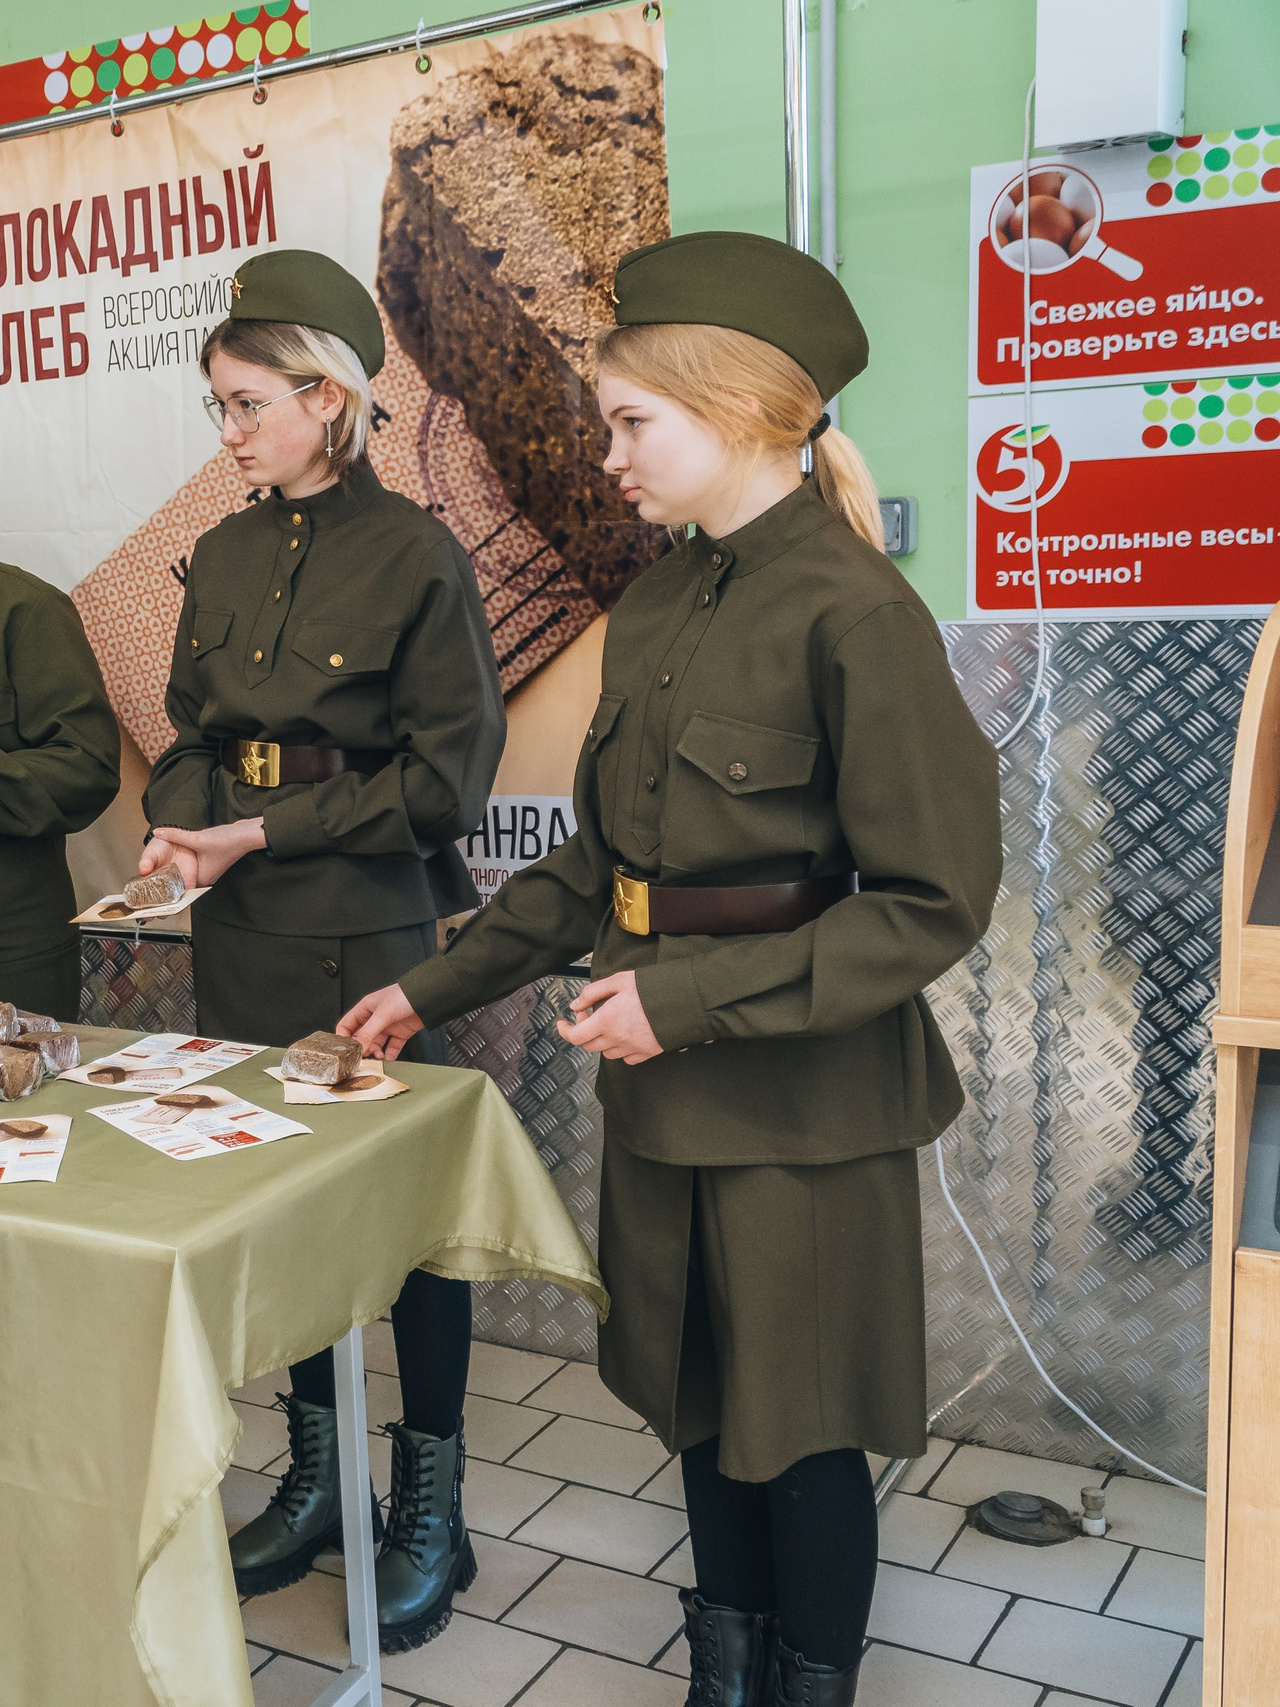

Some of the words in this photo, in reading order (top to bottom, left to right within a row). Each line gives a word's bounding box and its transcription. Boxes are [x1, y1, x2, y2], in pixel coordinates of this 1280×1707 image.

[1029, 296, 1156, 326] Свежее
[1165, 284, 1264, 313] яйцо.
[107, 331, 181, 373] АКЦИЯ
[996, 328, 1178, 367] Проверьте
[996, 530, 1192, 557] Контрольные
[996, 569, 1036, 587] это
[1046, 561, 1142, 586] точно!
